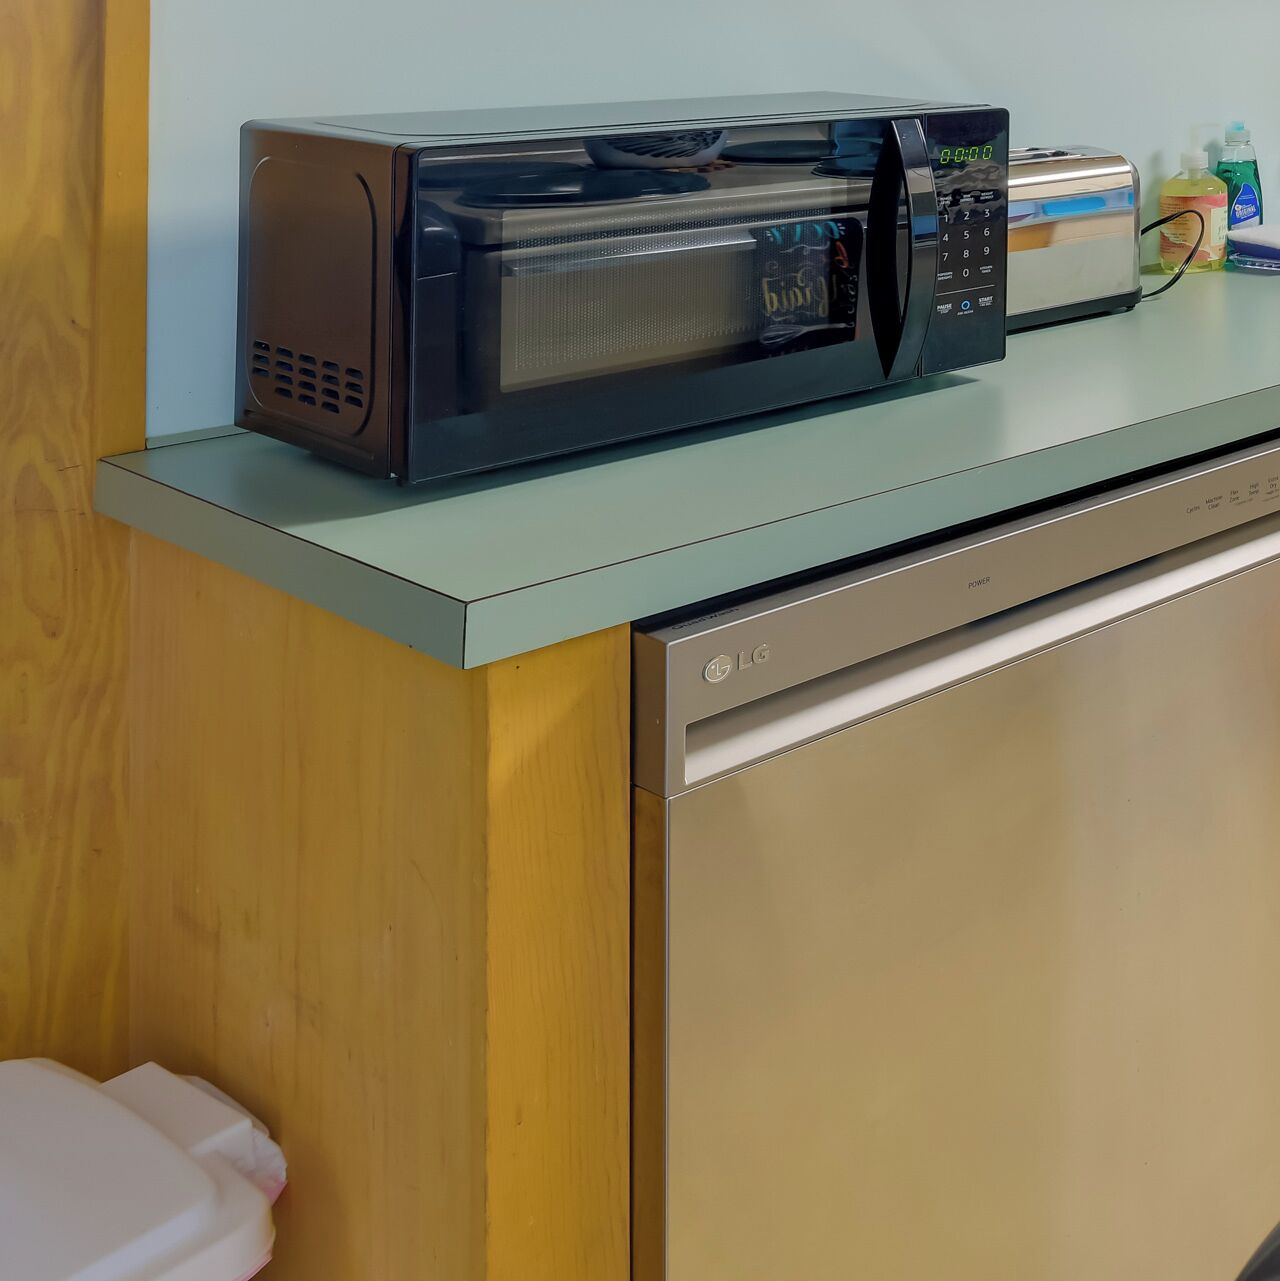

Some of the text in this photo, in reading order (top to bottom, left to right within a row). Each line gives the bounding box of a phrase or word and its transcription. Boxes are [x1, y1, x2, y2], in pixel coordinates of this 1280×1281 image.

[940, 145, 993, 164] 00:00
[964, 212, 970, 220] 2
[984, 209, 990, 218] 3
[943, 215, 948, 223] 1
[963, 230, 970, 240] 5
[983, 227, 990, 237] 6
[942, 234, 949, 242] 4
[963, 249, 970, 258] 8
[983, 246, 990, 255] 9
[942, 252, 949, 261] 7
[962, 268, 970, 278] 0
[968, 576, 991, 589] POWER
[737, 643, 770, 671] LG
